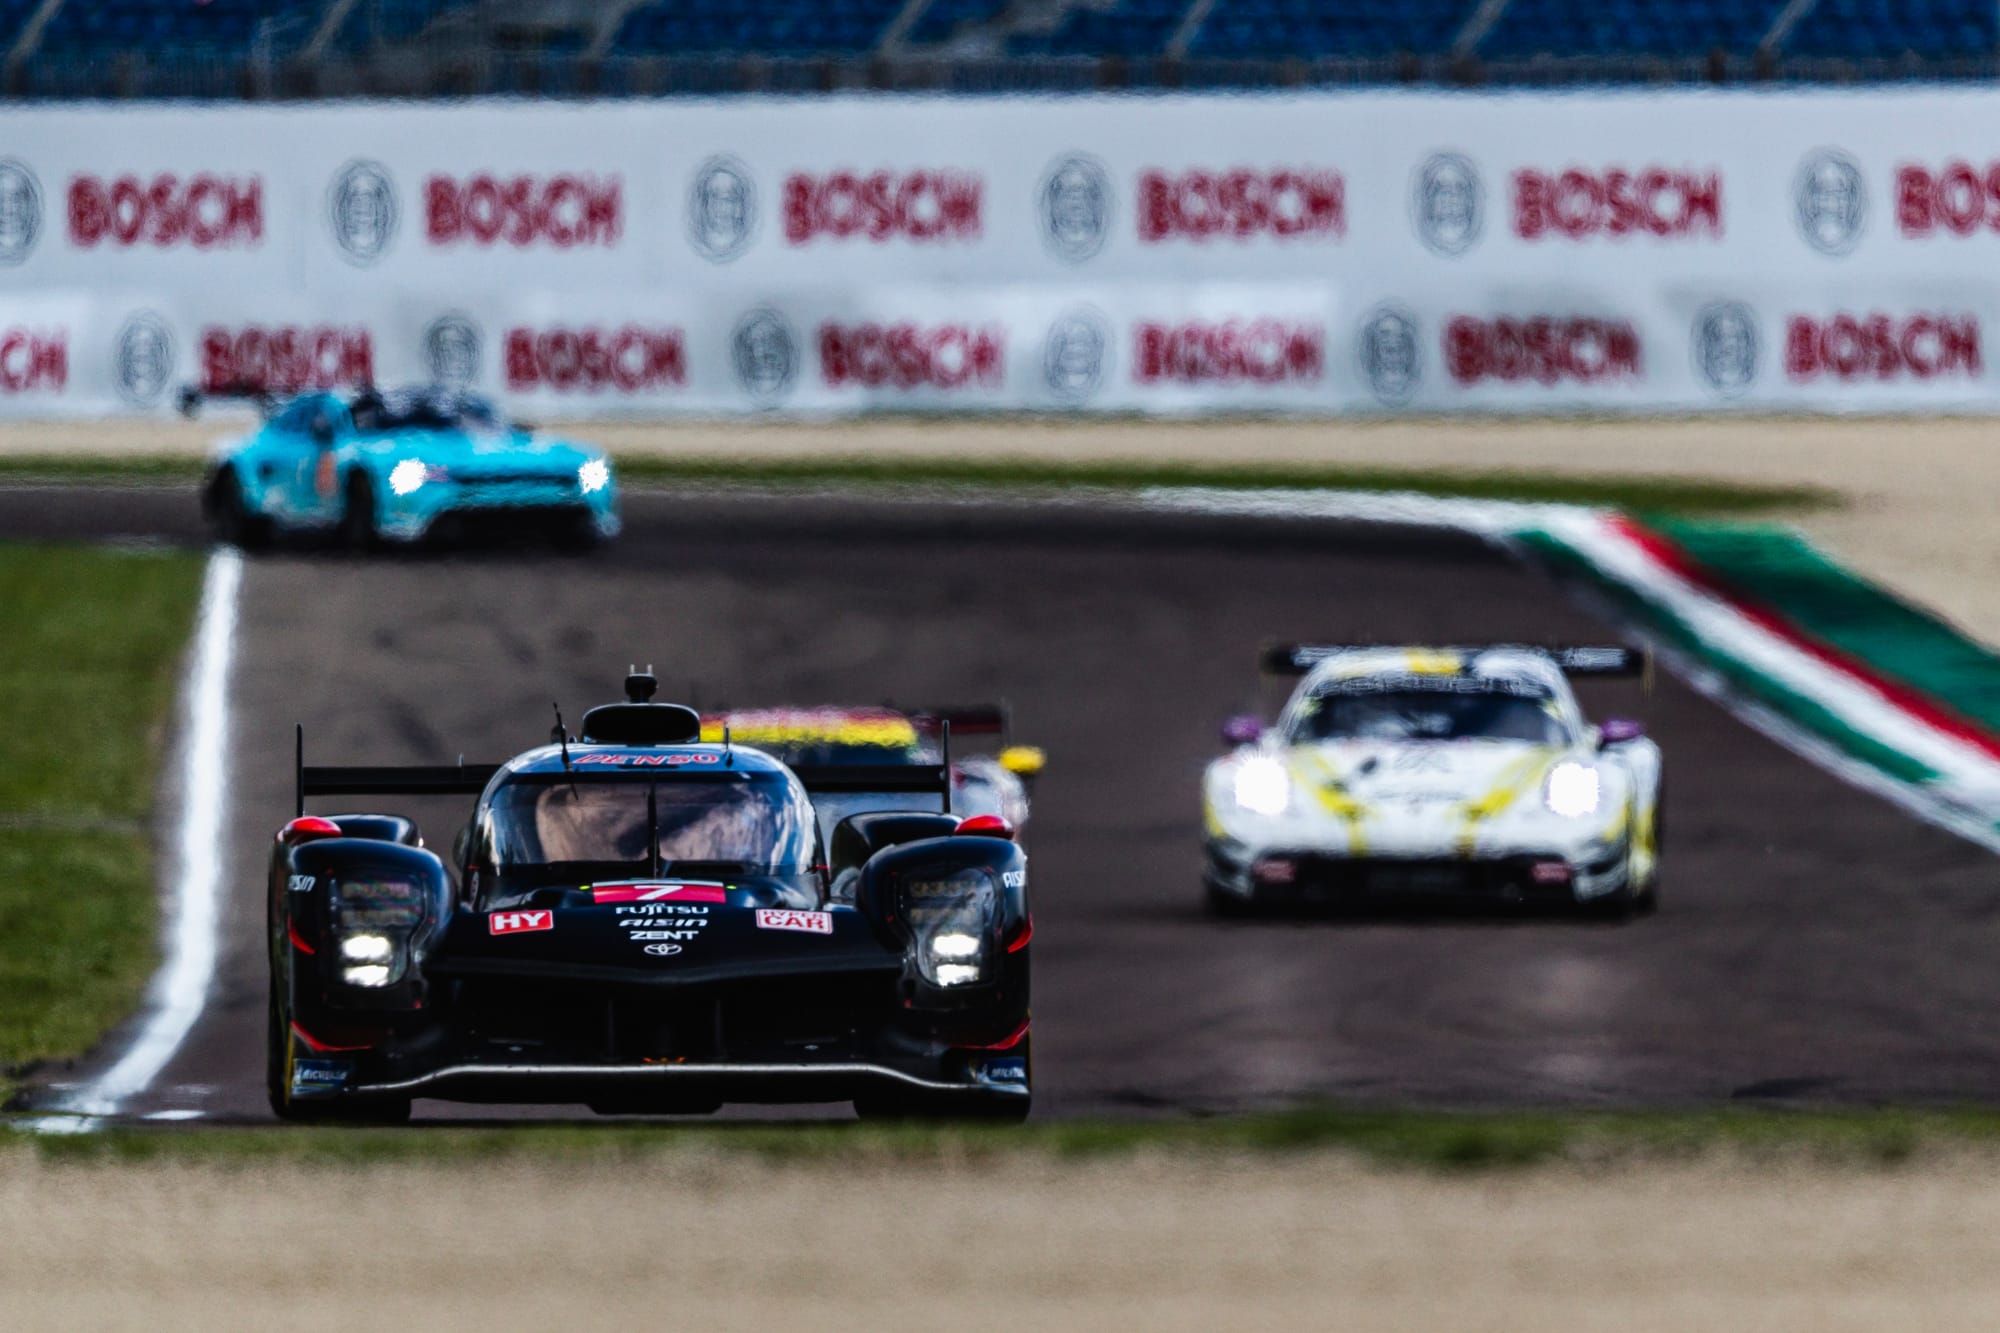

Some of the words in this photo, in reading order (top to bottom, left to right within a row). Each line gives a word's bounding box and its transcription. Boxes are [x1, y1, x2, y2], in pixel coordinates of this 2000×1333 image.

[68, 175, 262, 247] BOSCH
[424, 175, 621, 248] BOSCH
[782, 171, 981, 245] BOSCH
[1138, 170, 1345, 242] BOSCH
[1513, 168, 1722, 240] BOSCH
[202, 330, 373, 390] BOSCH
[505, 327, 683, 390] BOSCH
[820, 325, 1002, 385] BOSCH
[1136, 323, 1320, 383] BOSCH
[1447, 317, 1638, 383] BOSCH
[1786, 315, 1980, 379] BOSCH
[572, 753, 719, 765] DENSO
[494, 912, 546, 930] HY
[615, 903, 709, 915] FUJITSU
[619, 919, 708, 927] AISIN
[634, 885, 684, 901] 7
[764, 916, 823, 929] CAR
[629, 930, 699, 940] ZENT
